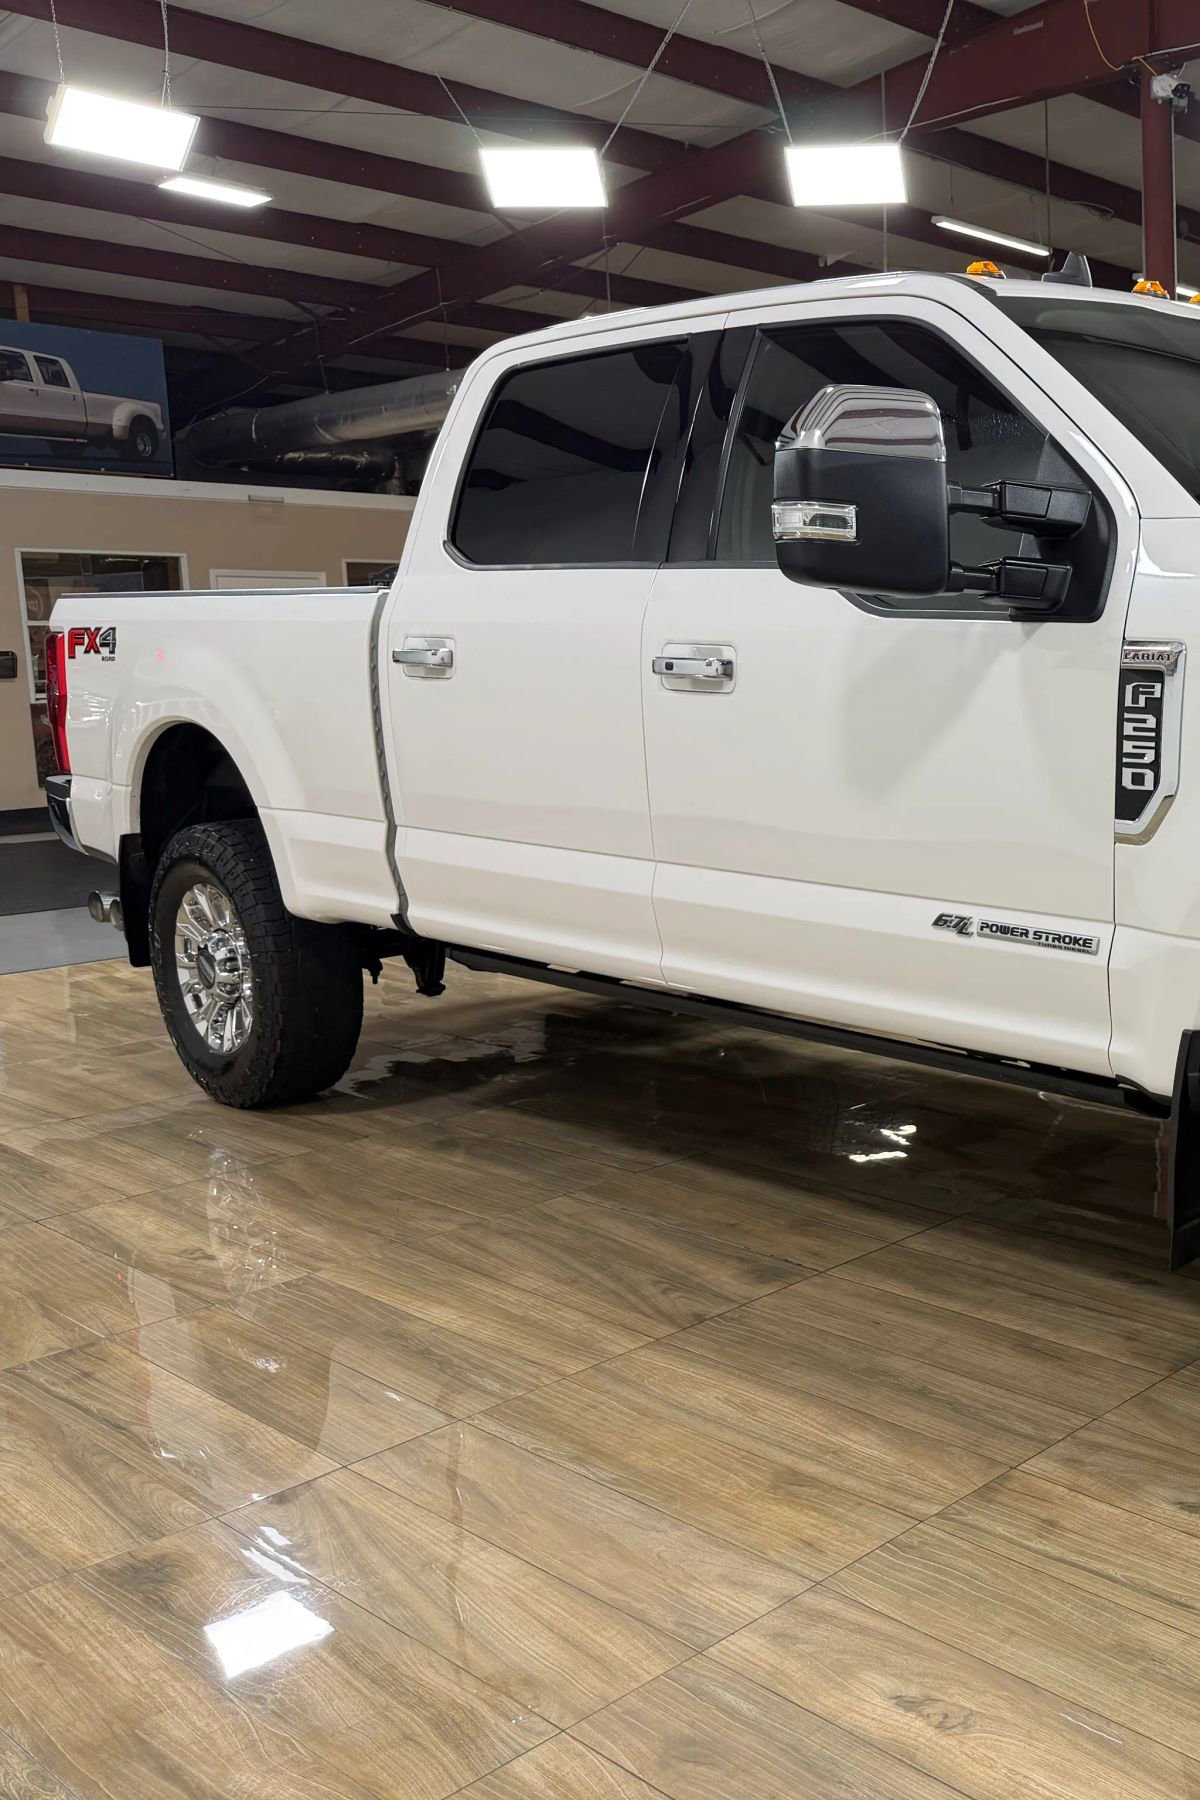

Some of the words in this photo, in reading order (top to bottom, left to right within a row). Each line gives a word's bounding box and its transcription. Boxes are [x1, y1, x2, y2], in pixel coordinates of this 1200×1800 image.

[68, 626, 117, 659] FX4
[1124, 651, 1173, 662] LARIAT
[1122, 682, 1162, 790] F250
[979, 921, 1029, 938] POWER
[1032, 930, 1094, 949] STROKE
